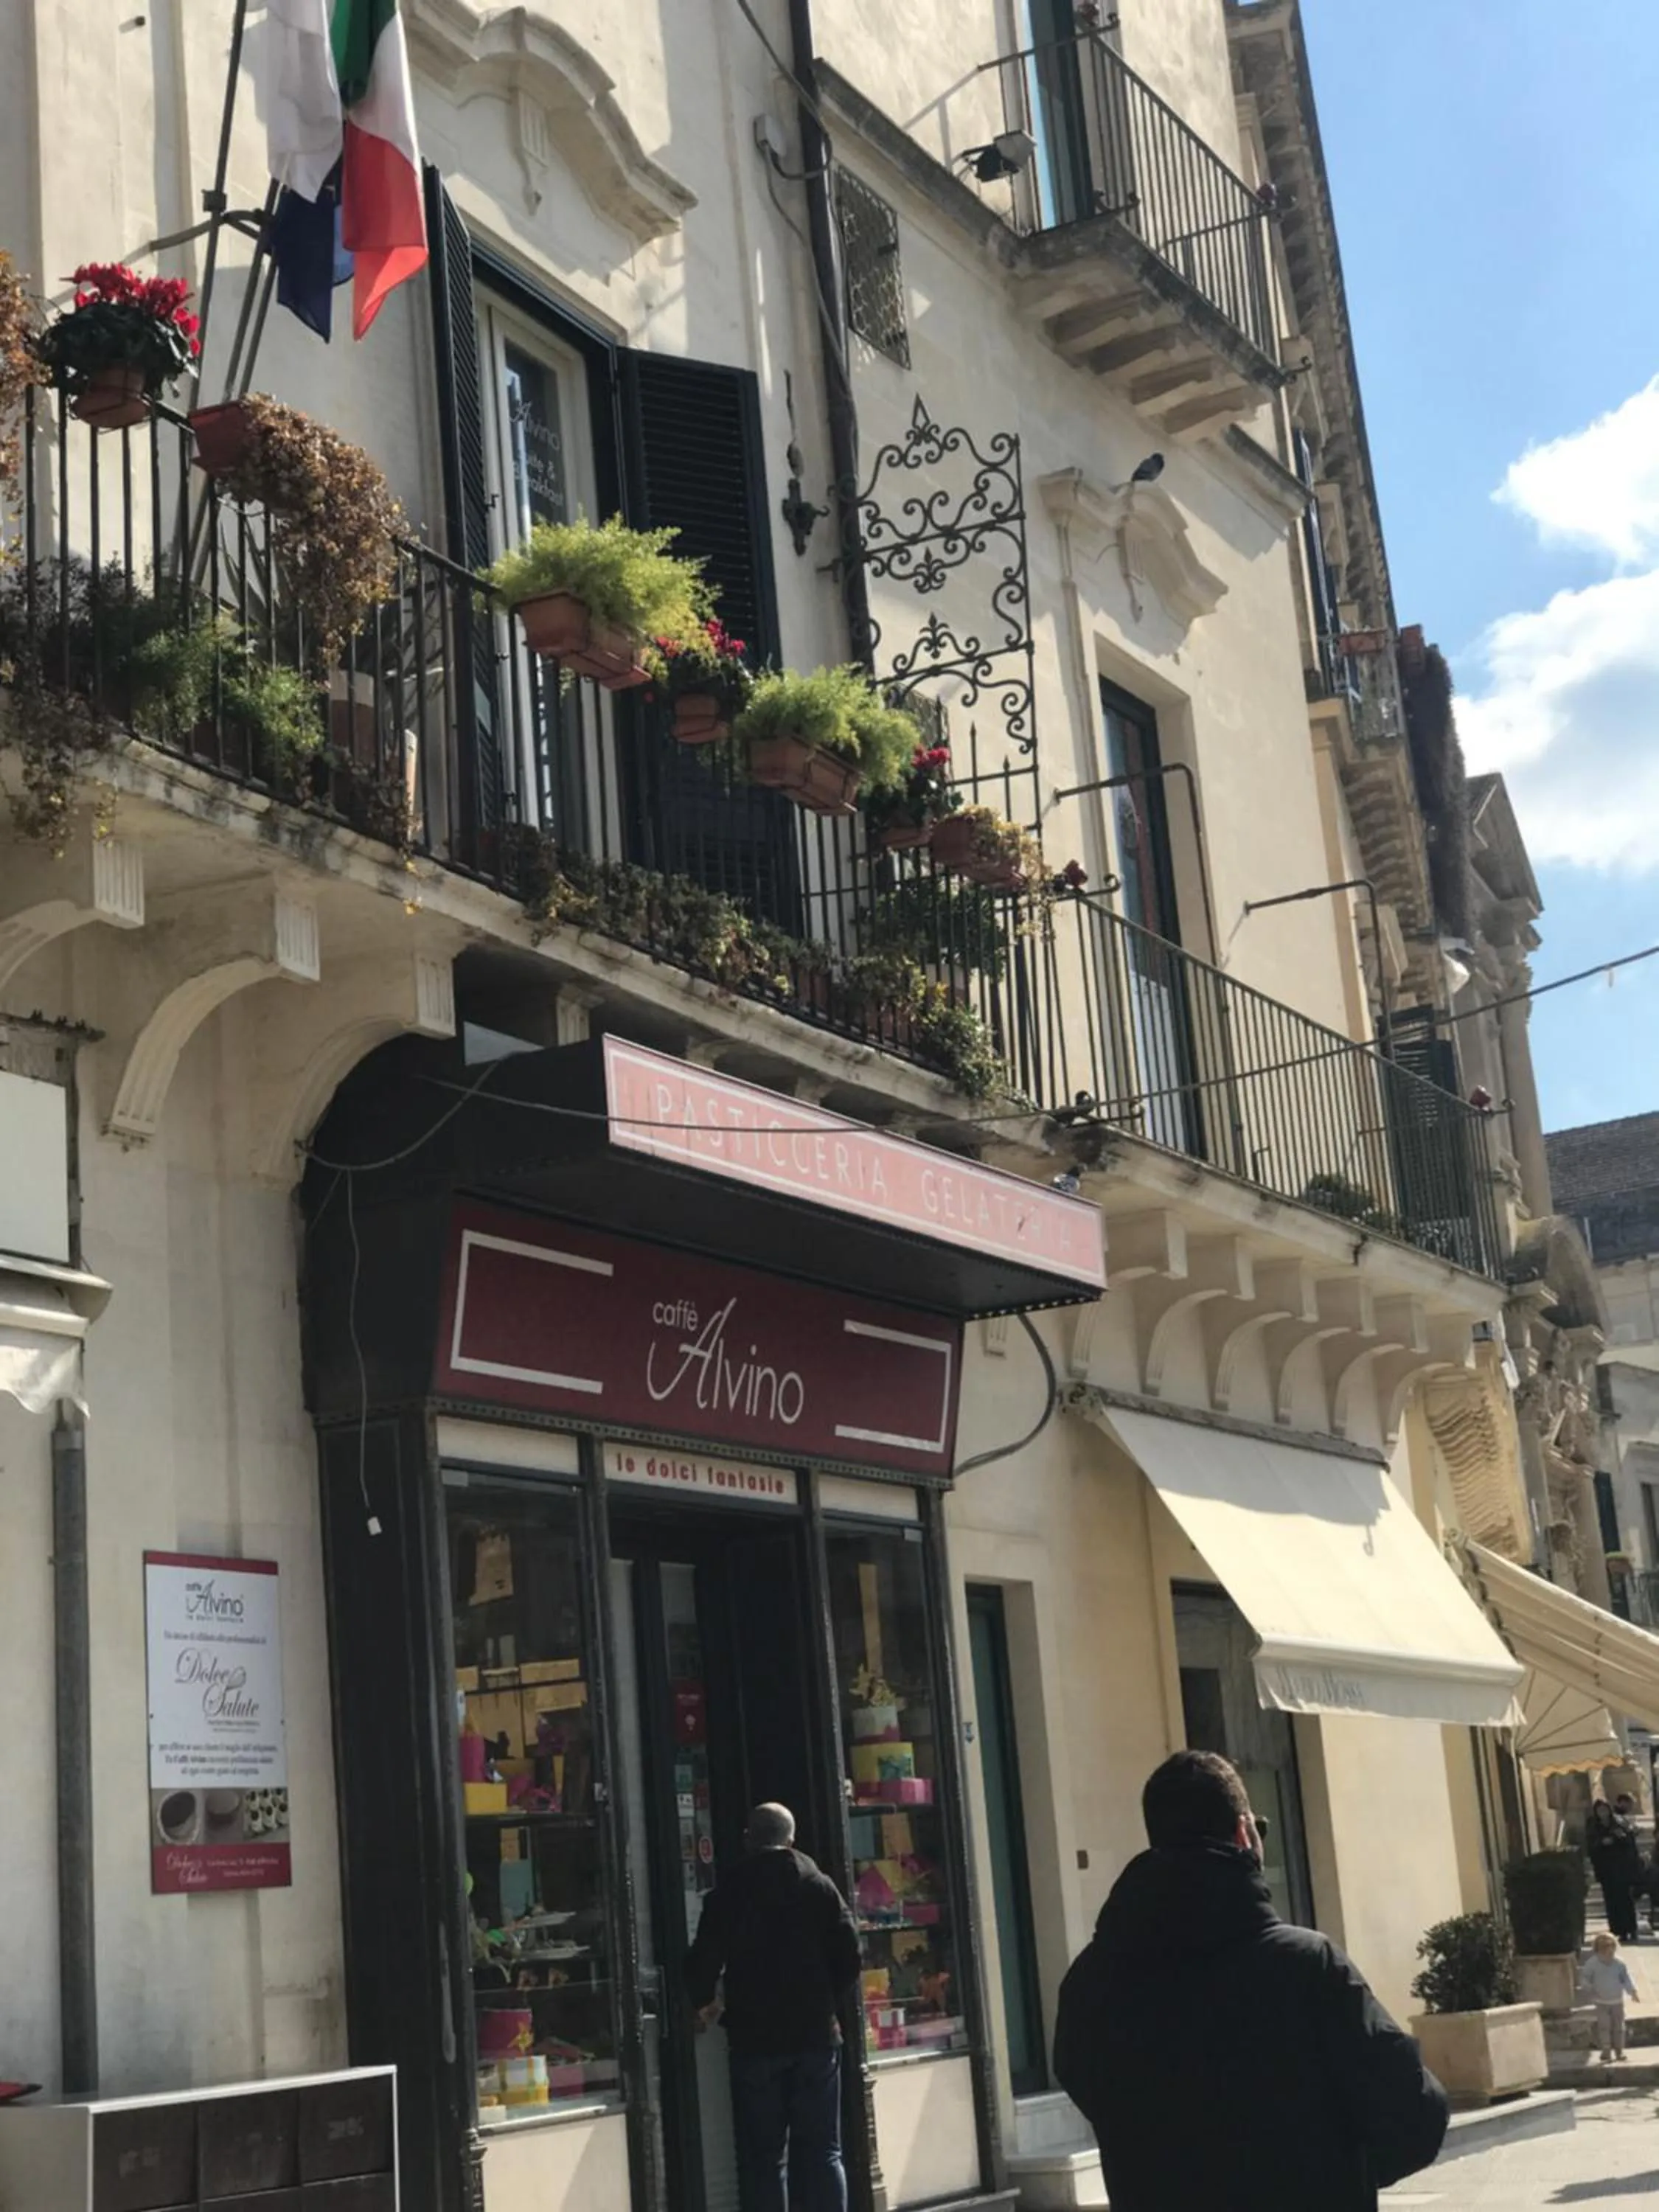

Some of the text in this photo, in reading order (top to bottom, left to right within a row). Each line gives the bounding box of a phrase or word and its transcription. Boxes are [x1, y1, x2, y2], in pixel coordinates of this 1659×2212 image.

[656, 1084, 1071, 1253] PASTICCERIA GELATERA
[653, 1298, 698, 1332] caffè
[647, 1297, 804, 1424] Alvino
[647, 1457, 698, 1482] dolci
[707, 1467, 785, 1494] fantasie
[186, 1579, 244, 1616] Alvino
